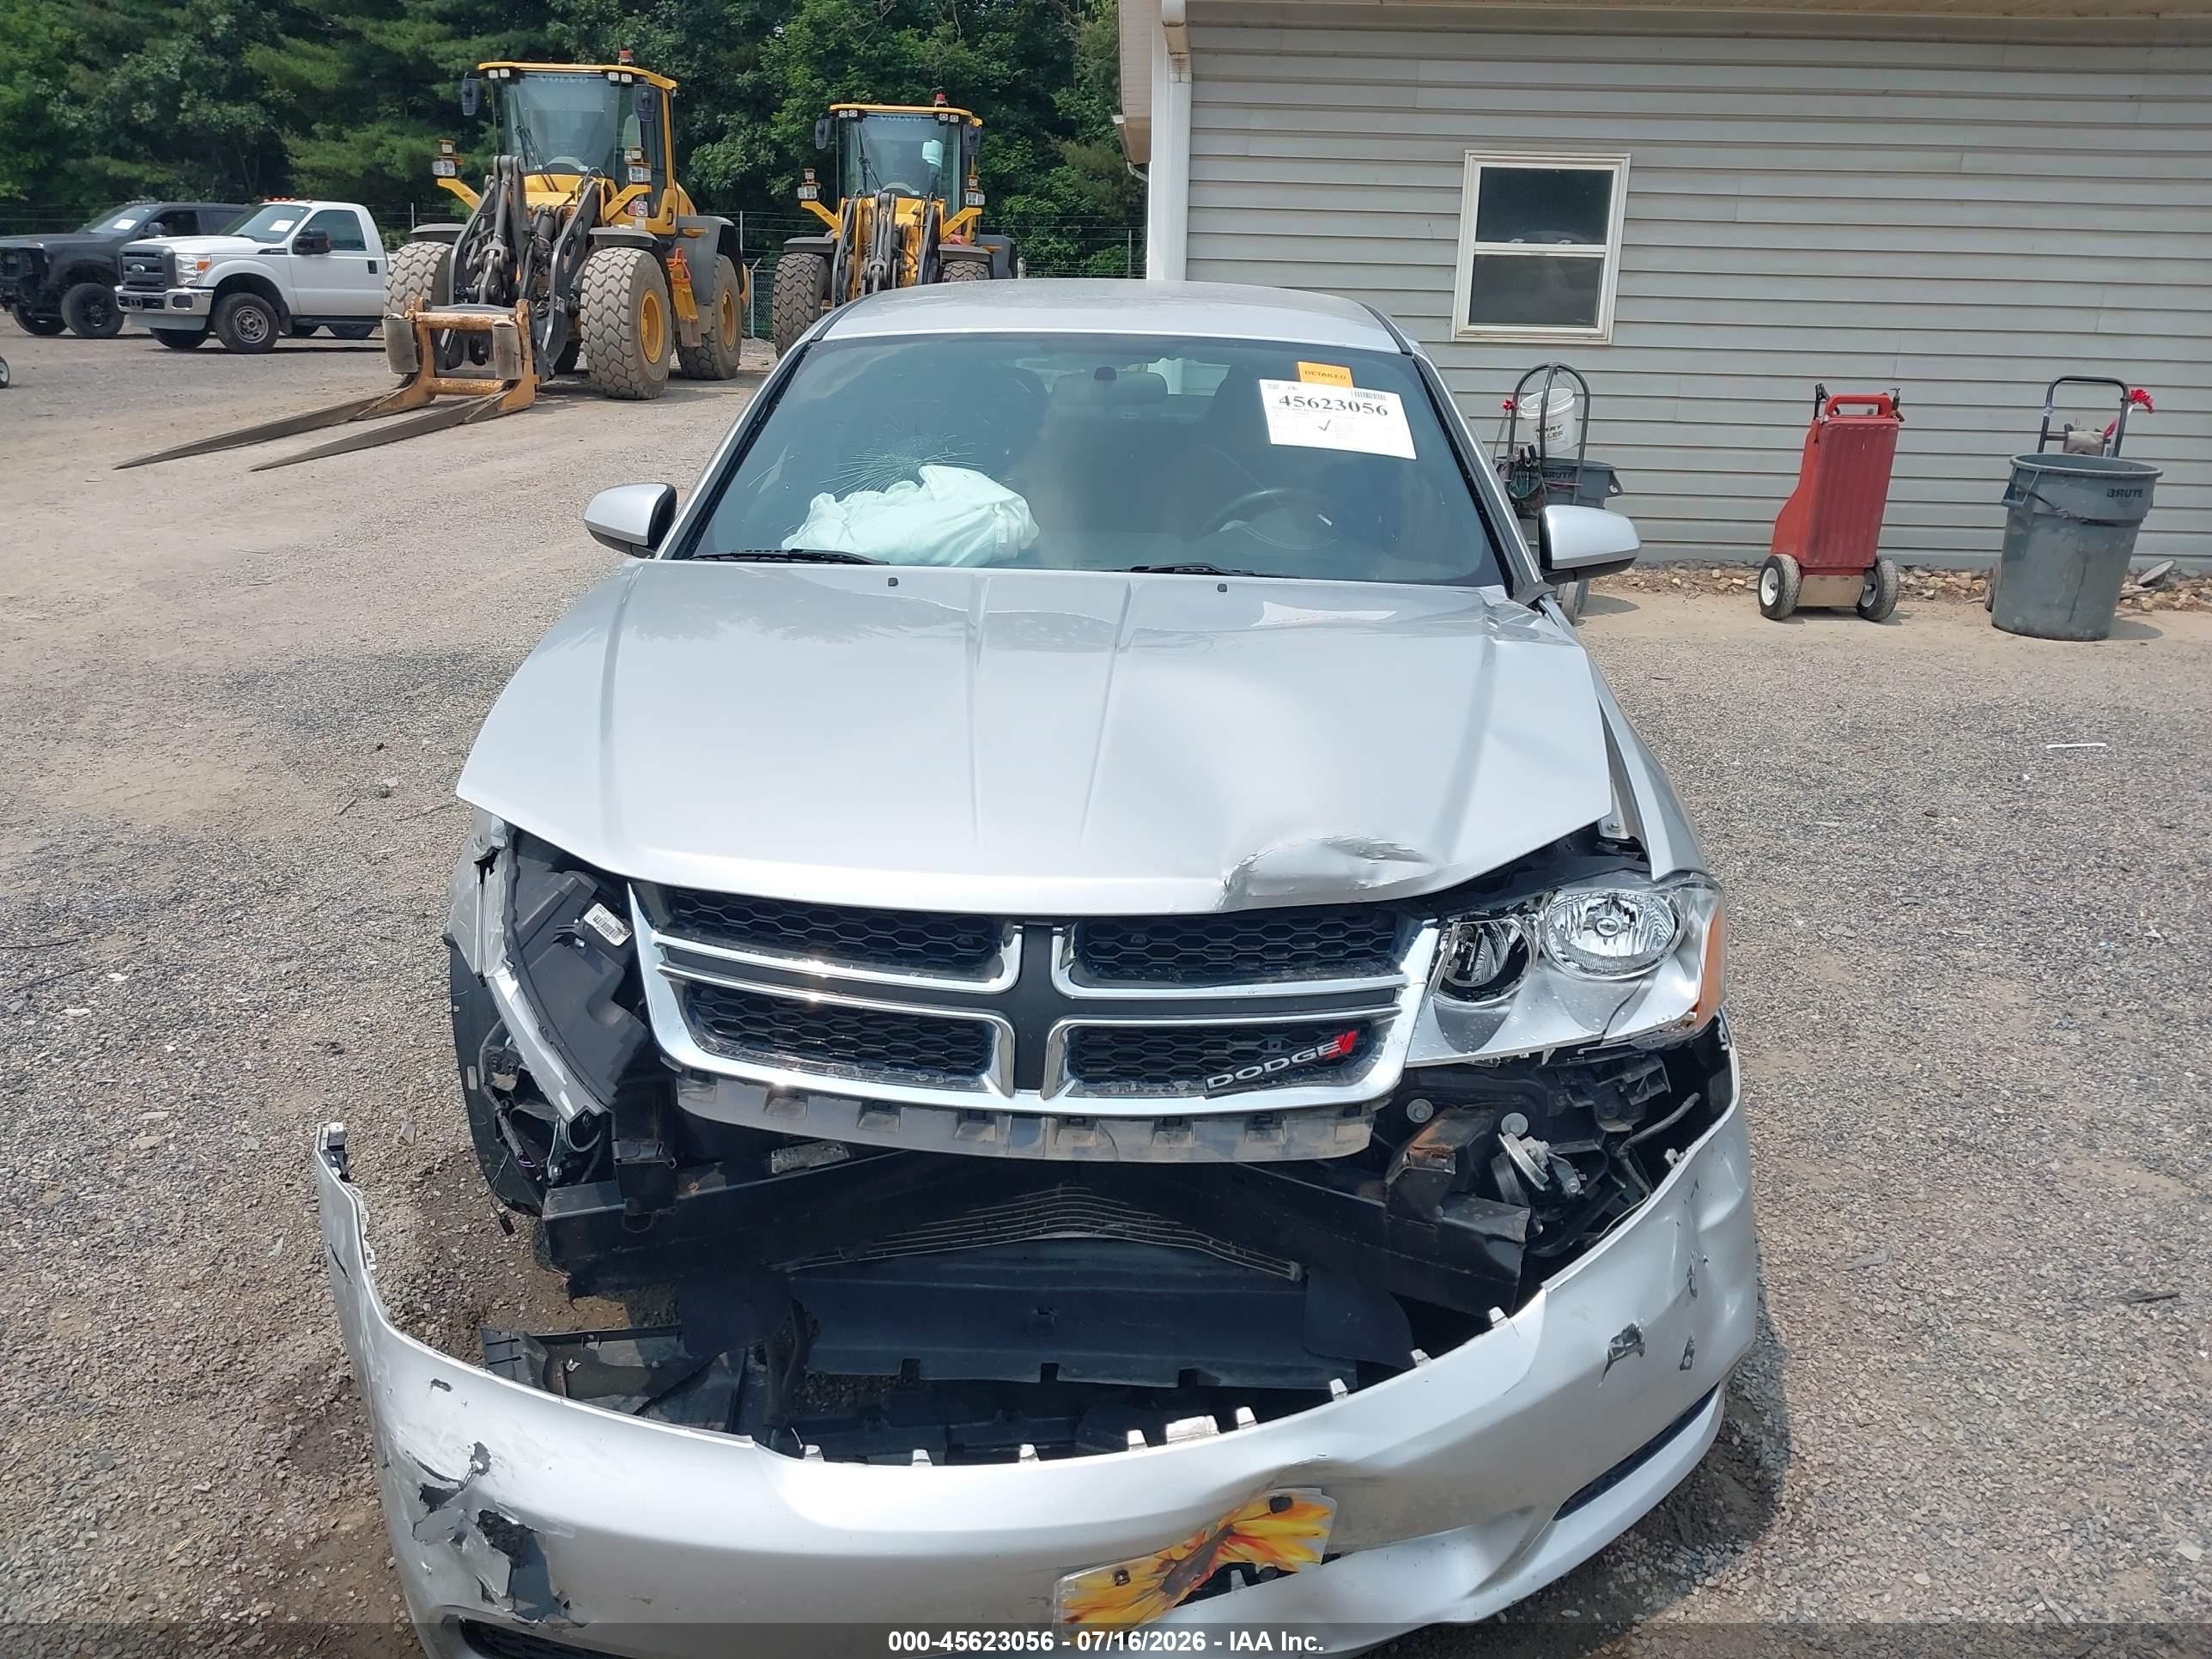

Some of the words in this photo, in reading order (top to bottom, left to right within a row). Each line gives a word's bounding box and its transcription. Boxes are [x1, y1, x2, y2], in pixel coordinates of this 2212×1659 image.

[1304, 370, 1347, 380] DETAILED
[1278, 395, 1389, 416] 45623056
[2106, 488, 2144, 498] BRUTE
[1206, 1039, 1342, 1089] DODGE
